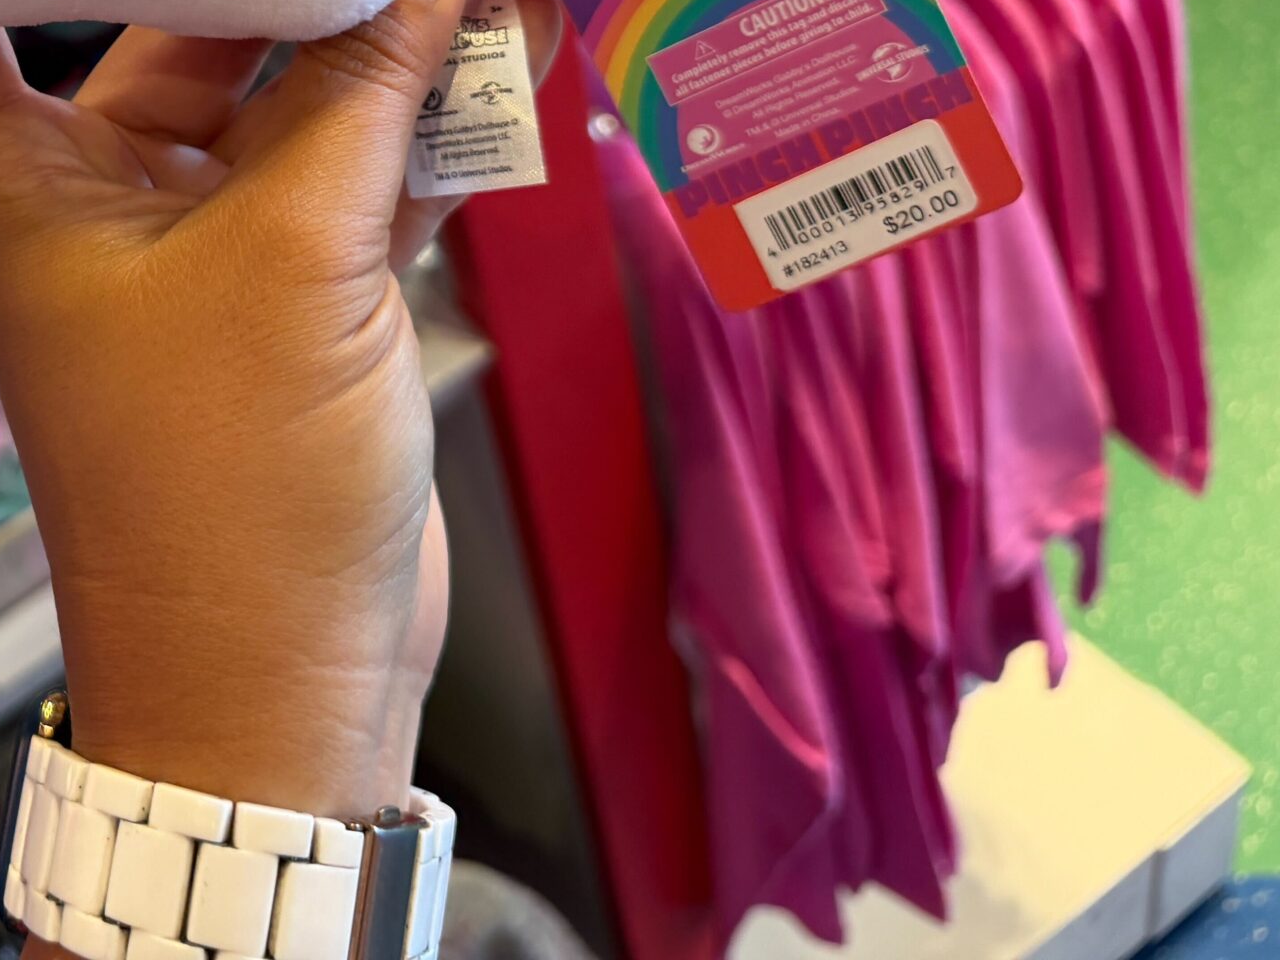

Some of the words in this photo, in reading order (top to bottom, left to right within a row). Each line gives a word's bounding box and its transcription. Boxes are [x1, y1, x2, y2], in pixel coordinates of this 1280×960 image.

[460, 50, 505, 63] STUDIOS
[670, 52, 729, 85] Completely
[727, 35, 767, 59] remove
[766, 25, 788, 41] this
[787, 17, 808, 34] tag
[805, 7, 827, 24] and
[673, 83, 689, 97] all
[687, 64, 732, 91] fastener
[730, 50, 764, 72] pieces
[763, 35, 798, 57] before
[797, 20, 832, 43] giving
[830, 14, 844, 27] to
[843, 1, 874, 21] child.
[673, 130, 822, 219] PINCH
[817, 66, 975, 161] PINCH
[765, 245, 777, 258] 4
[796, 208, 859, 244] 00013
[862, 179, 926, 215] 95829
[945, 165, 958, 179] 7
[881, 187, 960, 235] $20.00
[780, 238, 849, 278] #182413
